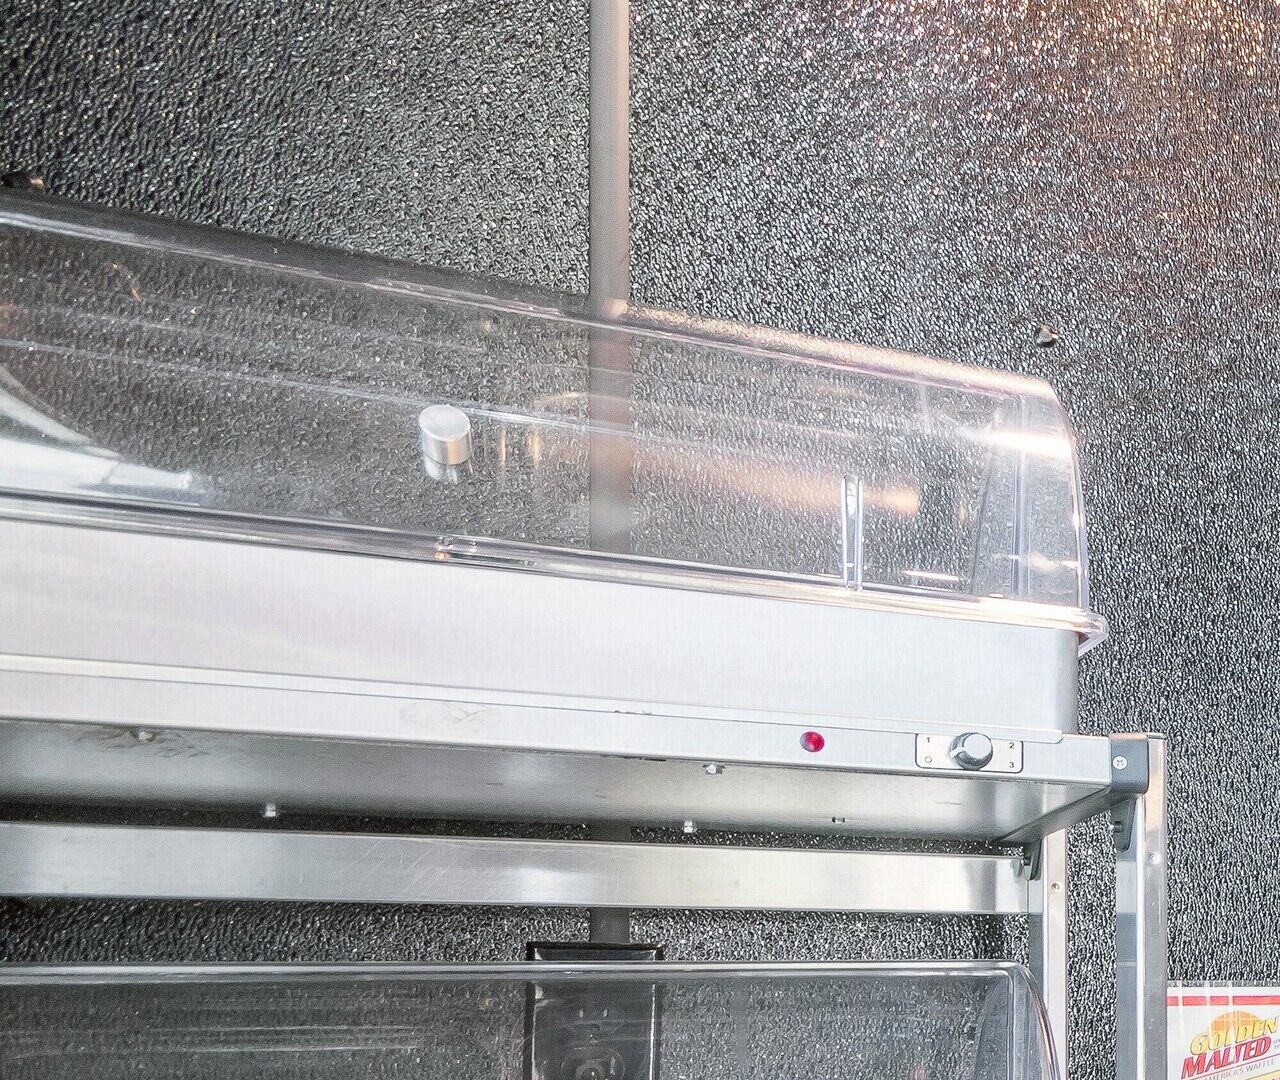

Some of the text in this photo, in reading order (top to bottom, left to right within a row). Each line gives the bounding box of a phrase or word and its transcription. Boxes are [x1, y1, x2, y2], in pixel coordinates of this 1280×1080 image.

[1190, 1016, 1279, 1055] GOLDEN
[1181, 1036, 1272, 1080] MALTED
[1246, 1059, 1275, 1073] WAFFLE
